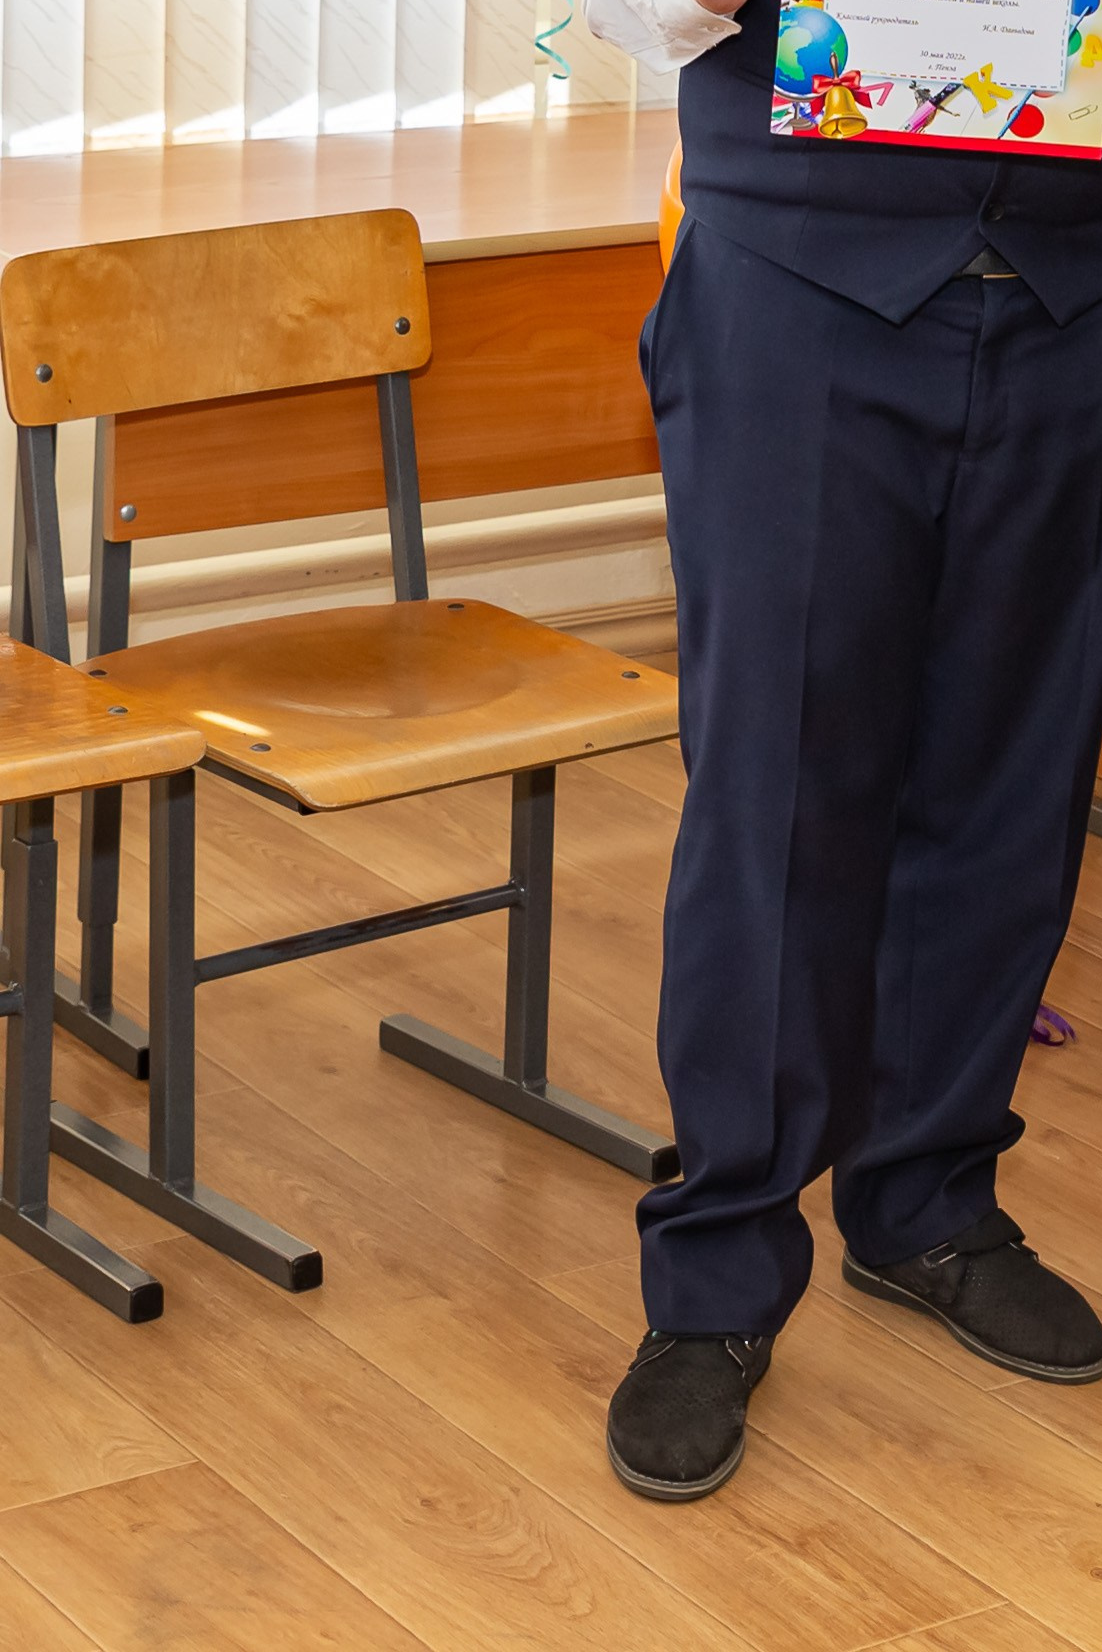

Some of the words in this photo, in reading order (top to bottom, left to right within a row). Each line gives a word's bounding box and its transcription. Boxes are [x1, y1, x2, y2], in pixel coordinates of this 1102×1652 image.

[836, 13, 870, 21] Классный
[871, 17, 919, 25] руководитель
[935, 64, 956, 72] Пенза
